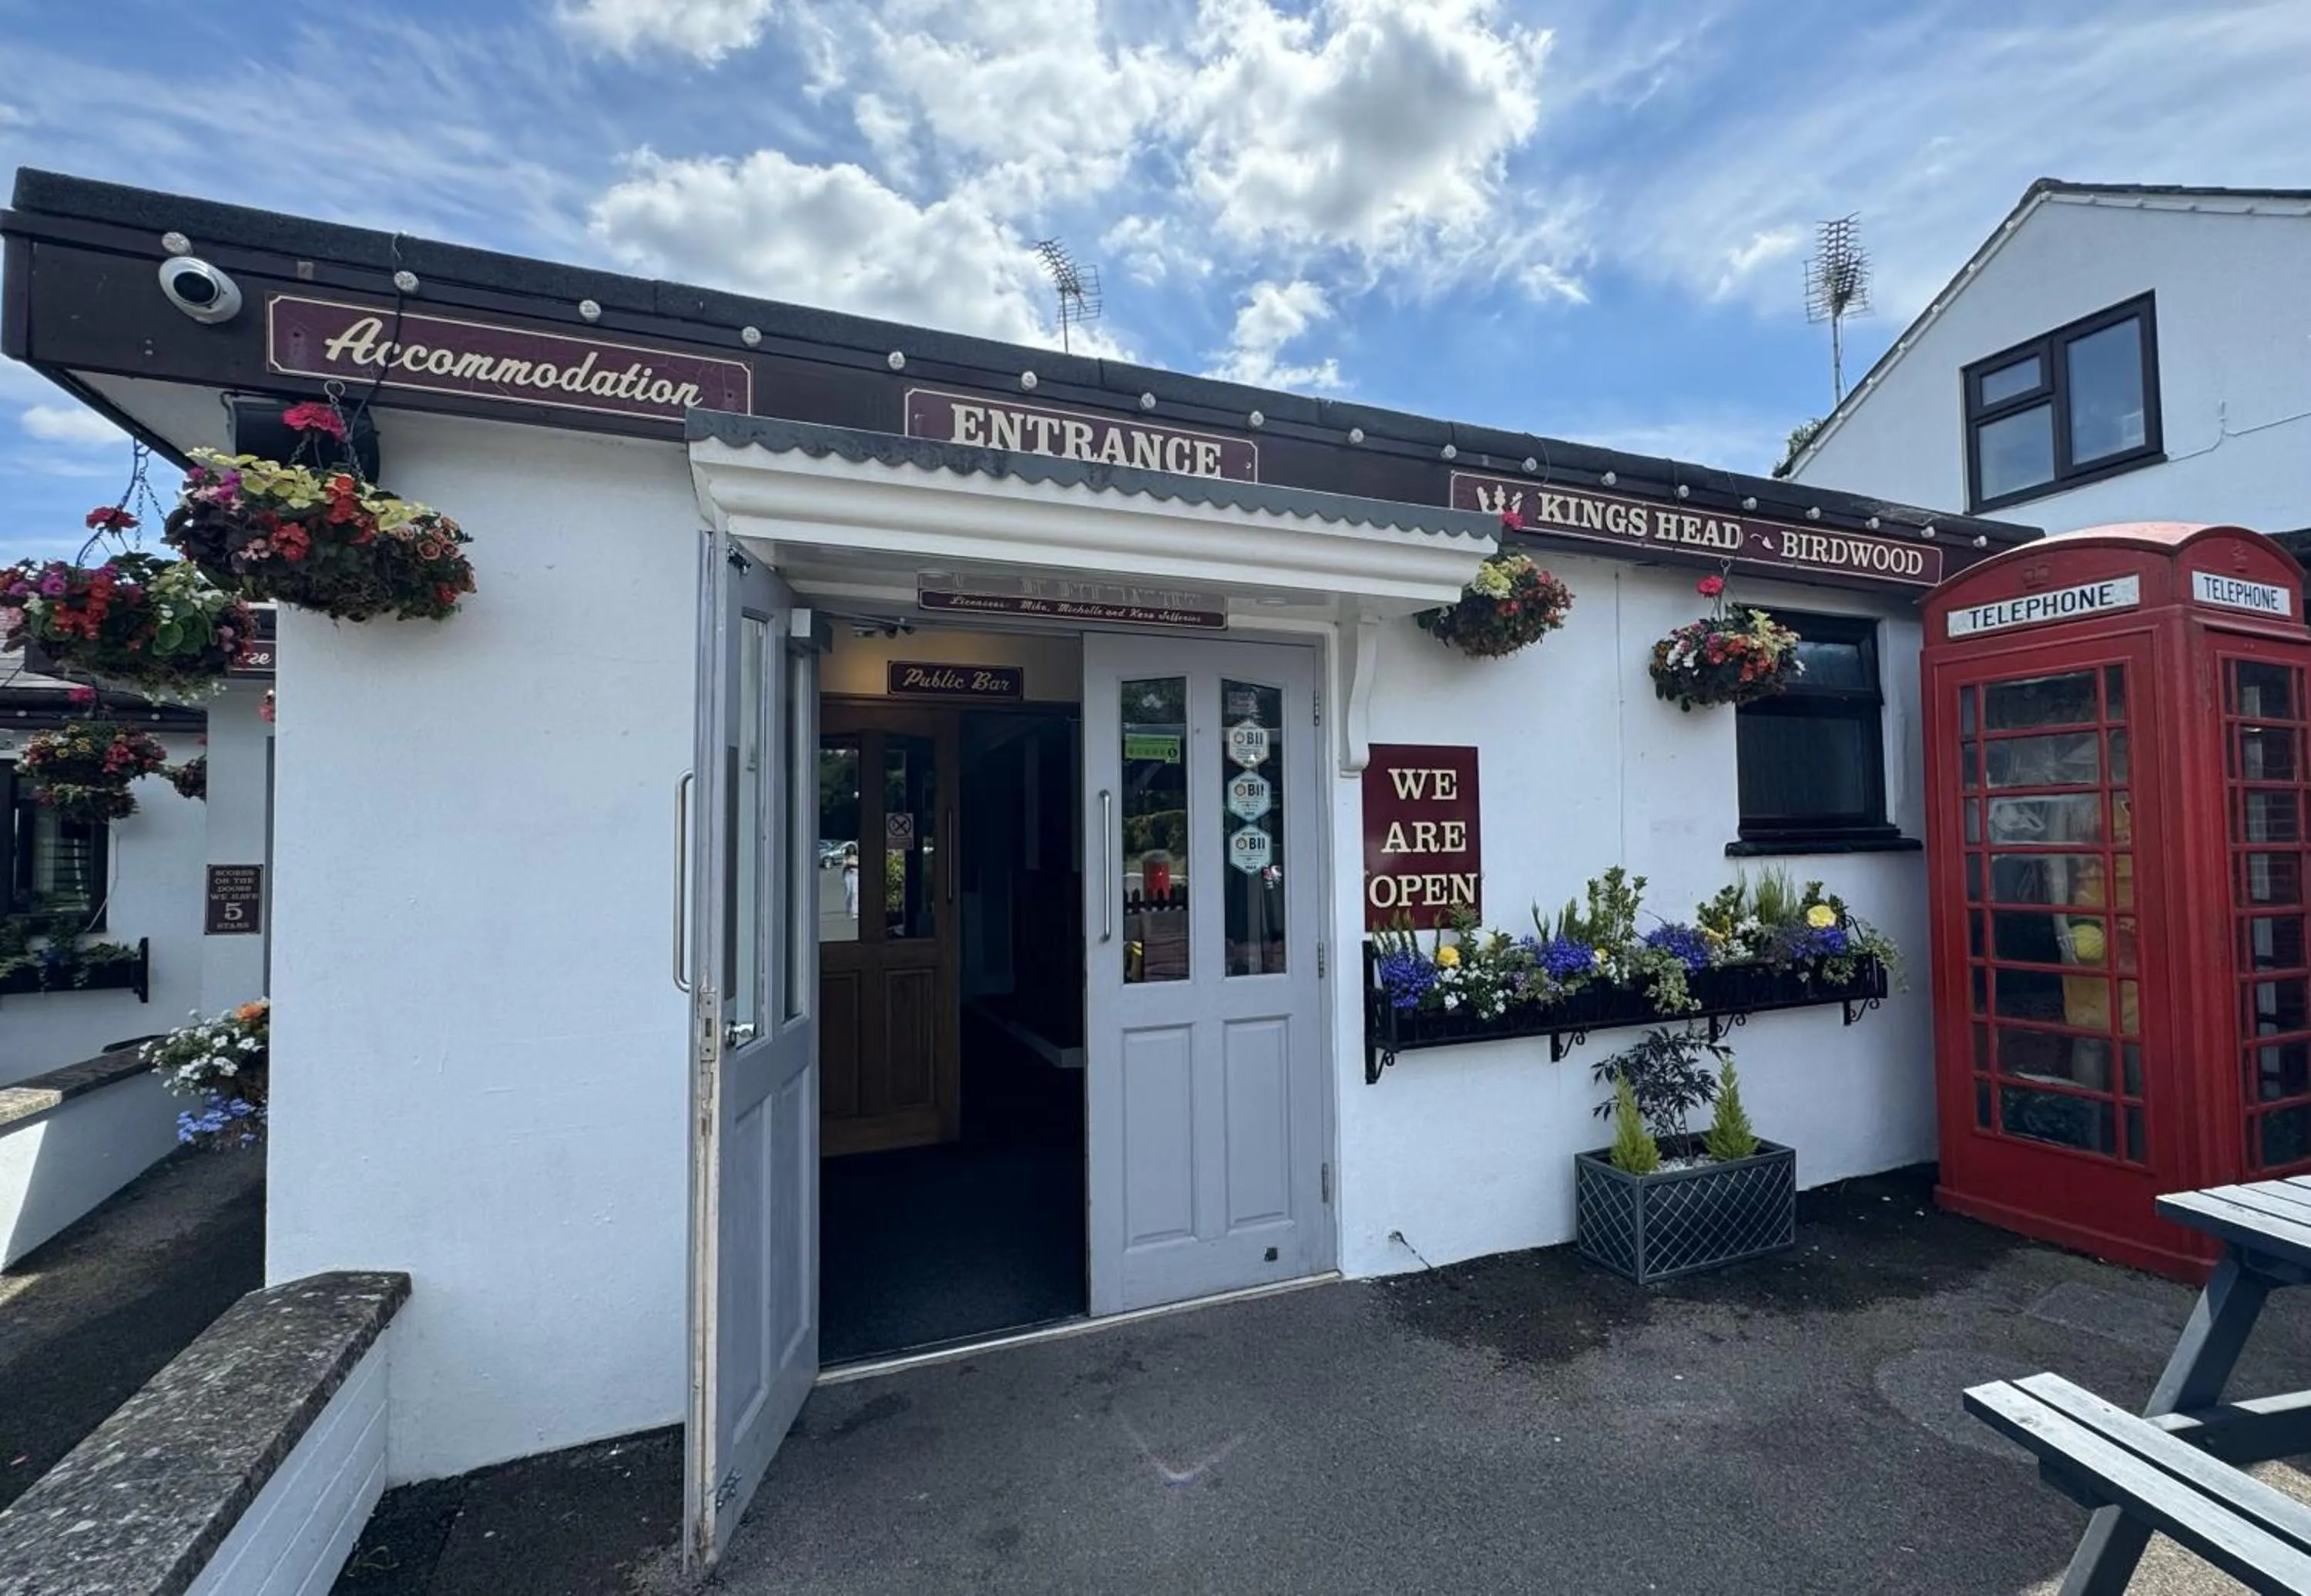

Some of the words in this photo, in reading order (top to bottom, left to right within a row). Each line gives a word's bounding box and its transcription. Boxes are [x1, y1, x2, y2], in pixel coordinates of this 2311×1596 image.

[324, 317, 703, 407] Accommodation
[950, 402, 1222, 480] ENTRANCE
[1538, 492, 1648, 538] KINGS
[1654, 510, 1743, 551] HEAD
[1780, 531, 1924, 575] BIRDWOOD
[1058, 603, 1103, 616] Michelle
[1105, 608, 1124, 617] and
[1968, 583, 2115, 630] TELEPHONE
[2203, 577, 2279, 611] TELEPHONE
[902, 667, 964, 689] Public
[971, 671, 1011, 692] Bar
[1387, 768, 1457, 800] WE
[1380, 821, 1467, 853] ARE
[1368, 873, 1478, 908] OPEN
[224, 902, 243, 920] 5
